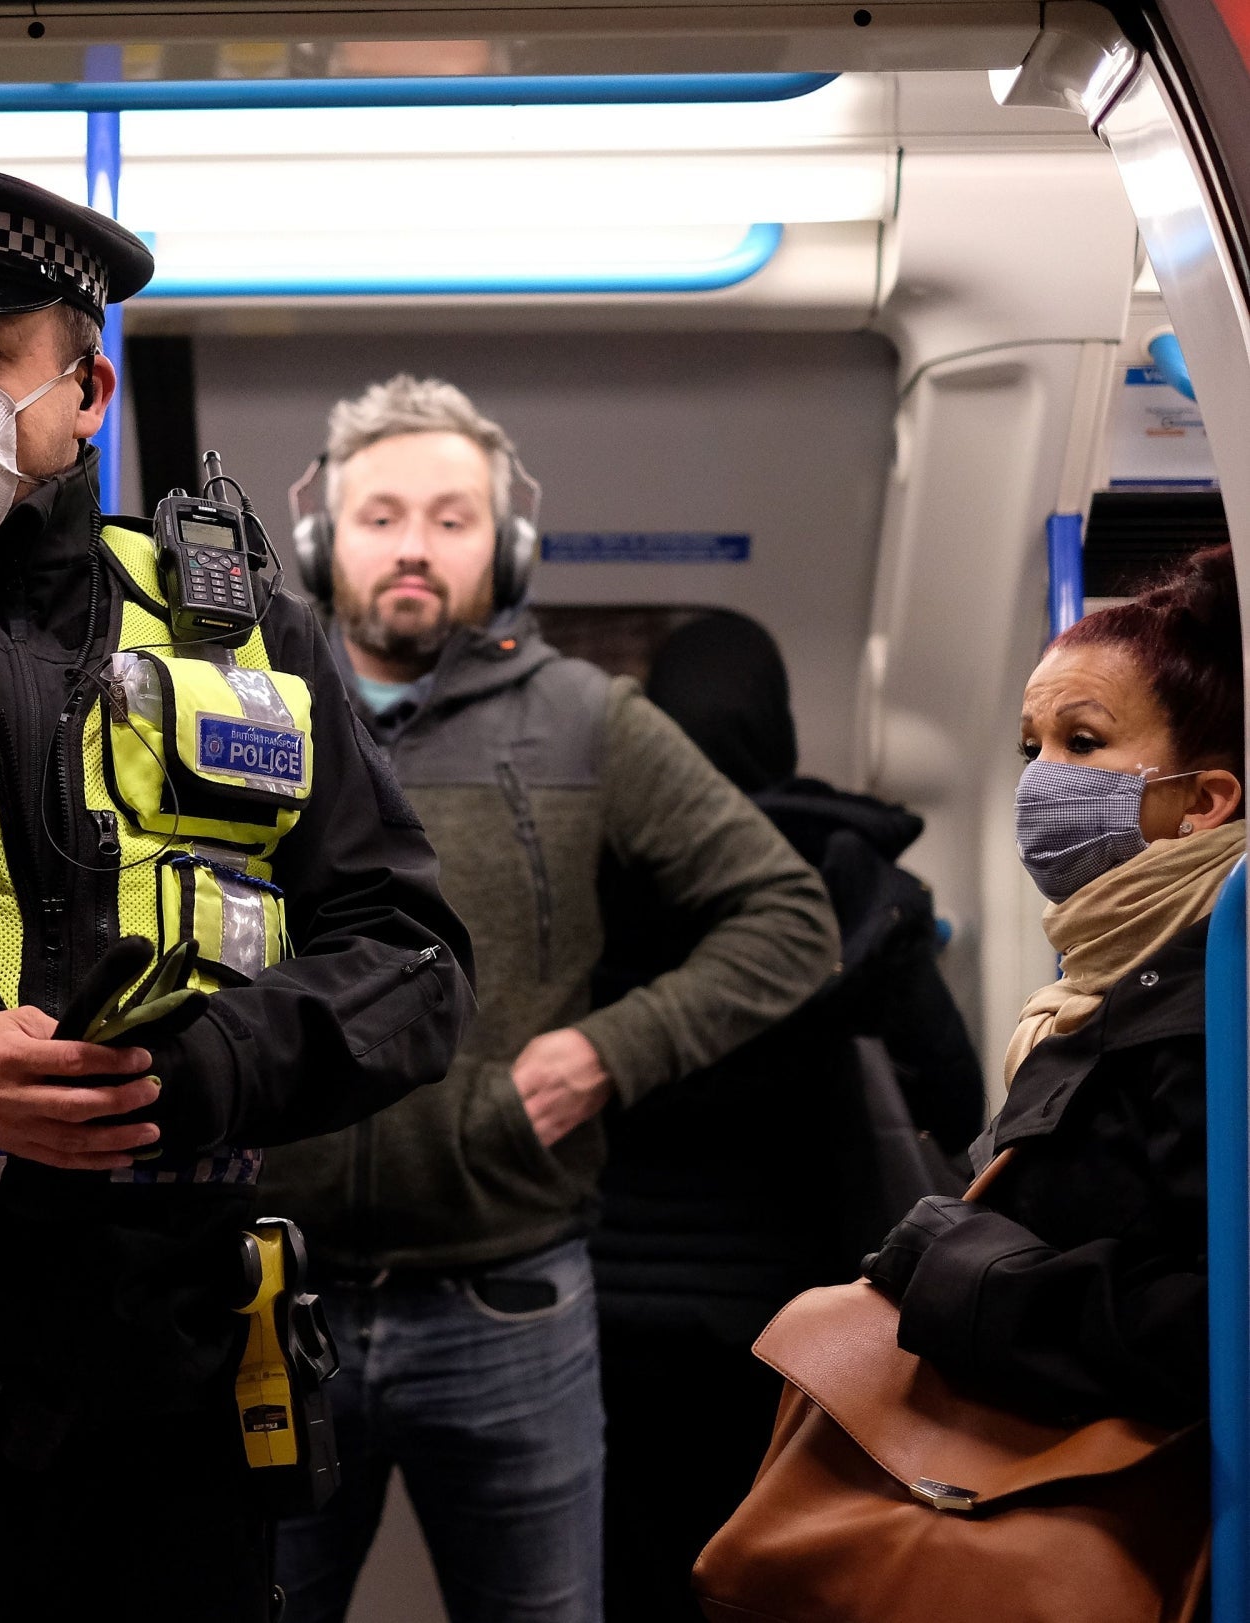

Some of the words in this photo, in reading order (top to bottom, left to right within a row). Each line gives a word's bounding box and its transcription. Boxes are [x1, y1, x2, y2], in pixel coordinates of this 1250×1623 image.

[231, 731, 259, 742] BRITISH
[261, 735, 300, 751] TRANSPOR
[230, 742, 299, 775] POLICE
